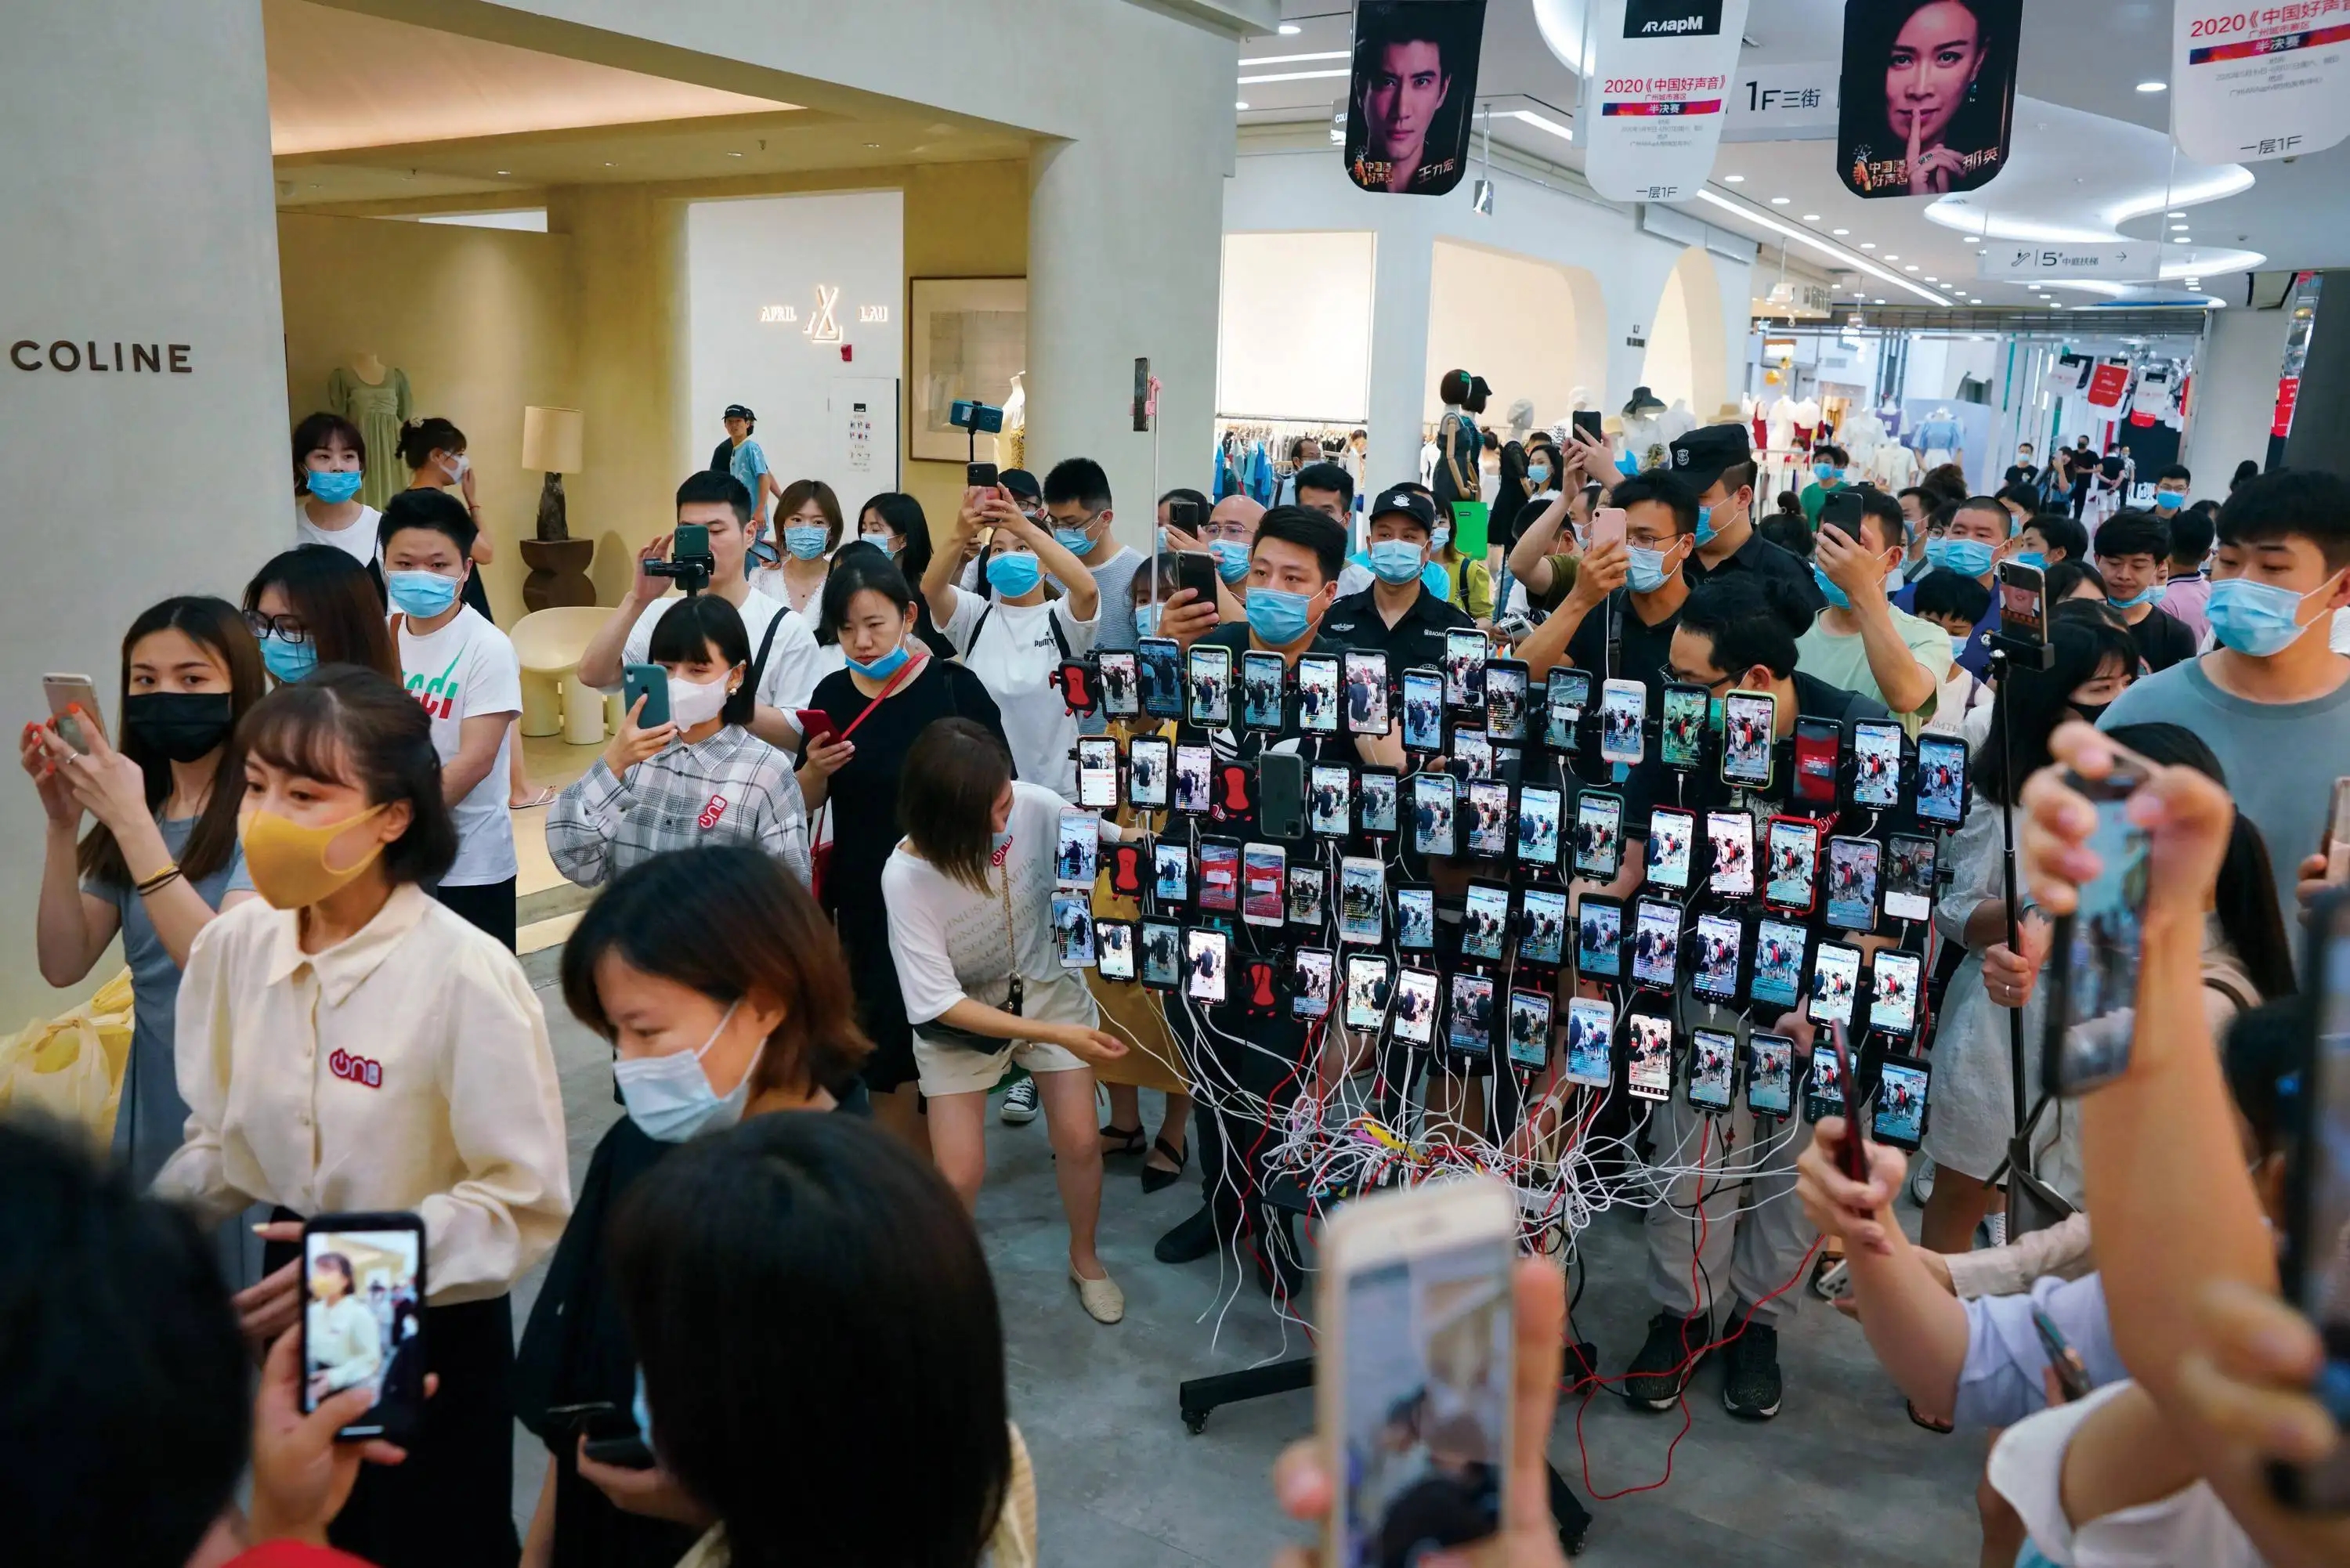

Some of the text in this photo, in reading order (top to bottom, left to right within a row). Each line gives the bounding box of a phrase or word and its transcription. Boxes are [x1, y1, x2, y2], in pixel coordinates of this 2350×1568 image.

[2255, 35, 2301, 52] 半决赛
[1649, 103, 1680, 114] 半决赛
[1962, 146, 1999, 172] 那英
[1418, 158, 1455, 184] 王力宏
[1636, 186, 1678, 199] 一层1F
[10, 340, 193, 373] COLINE
